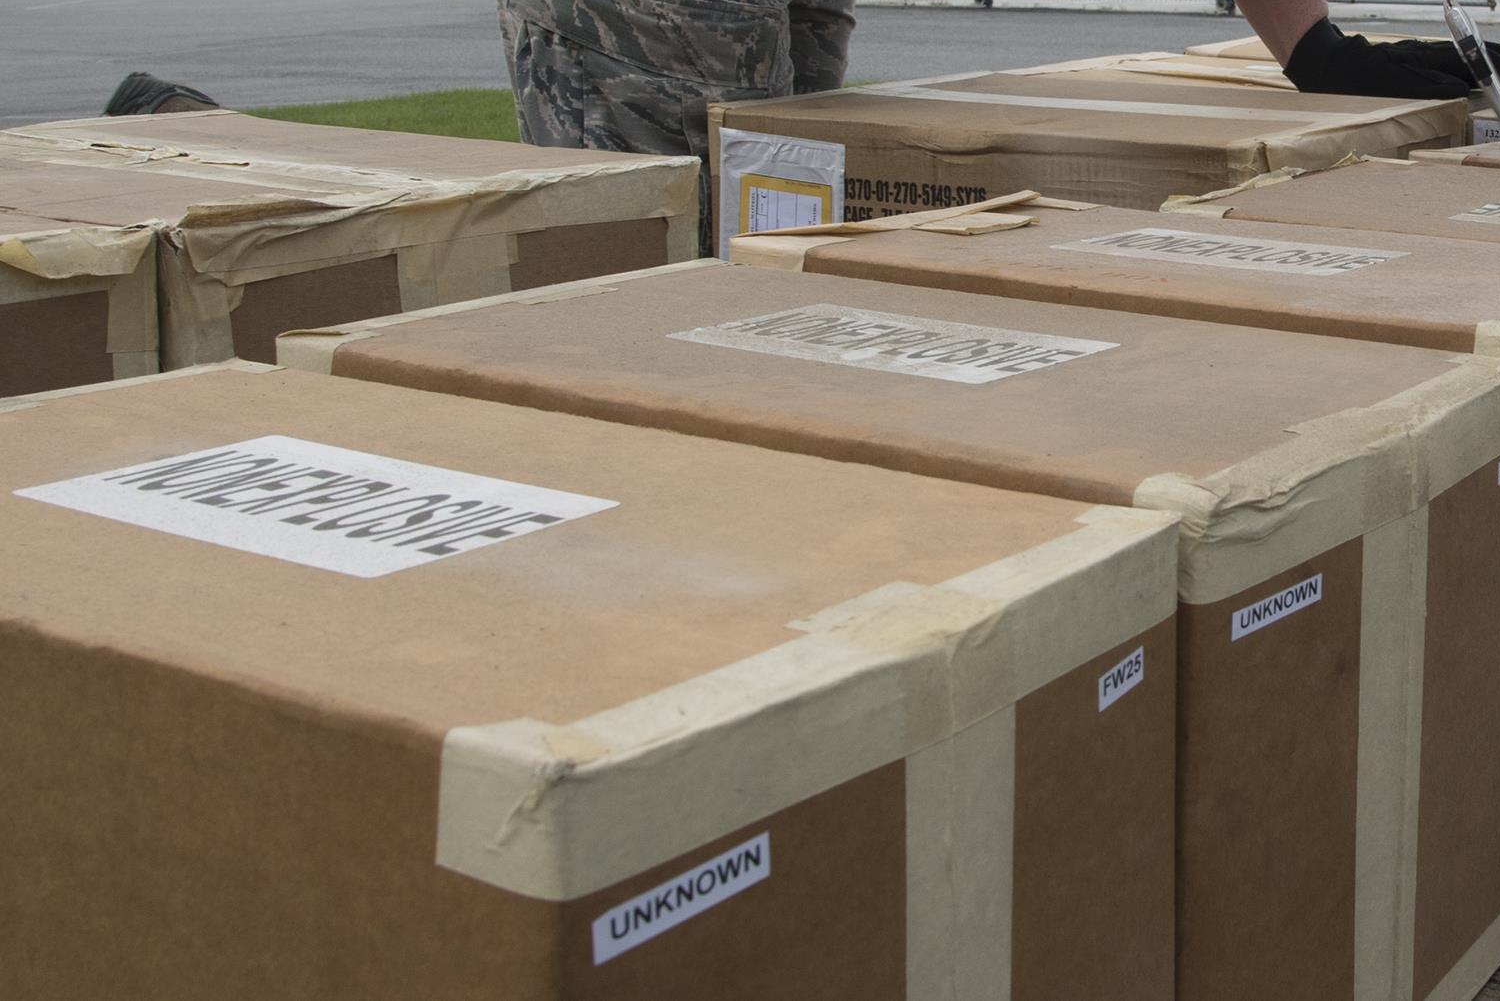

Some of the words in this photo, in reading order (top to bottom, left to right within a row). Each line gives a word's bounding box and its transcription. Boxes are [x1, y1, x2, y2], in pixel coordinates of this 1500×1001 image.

[1097, 233, 1388, 270] NONEXPLOSIVE
[720, 311, 1087, 374] NONEXPLOSIVE
[103, 449, 564, 556] NONEXPLOSIVE
[1240, 577, 1319, 629] UNKNOWN
[1102, 653, 1142, 697] FW25
[609, 843, 761, 940] UNKNOWN
